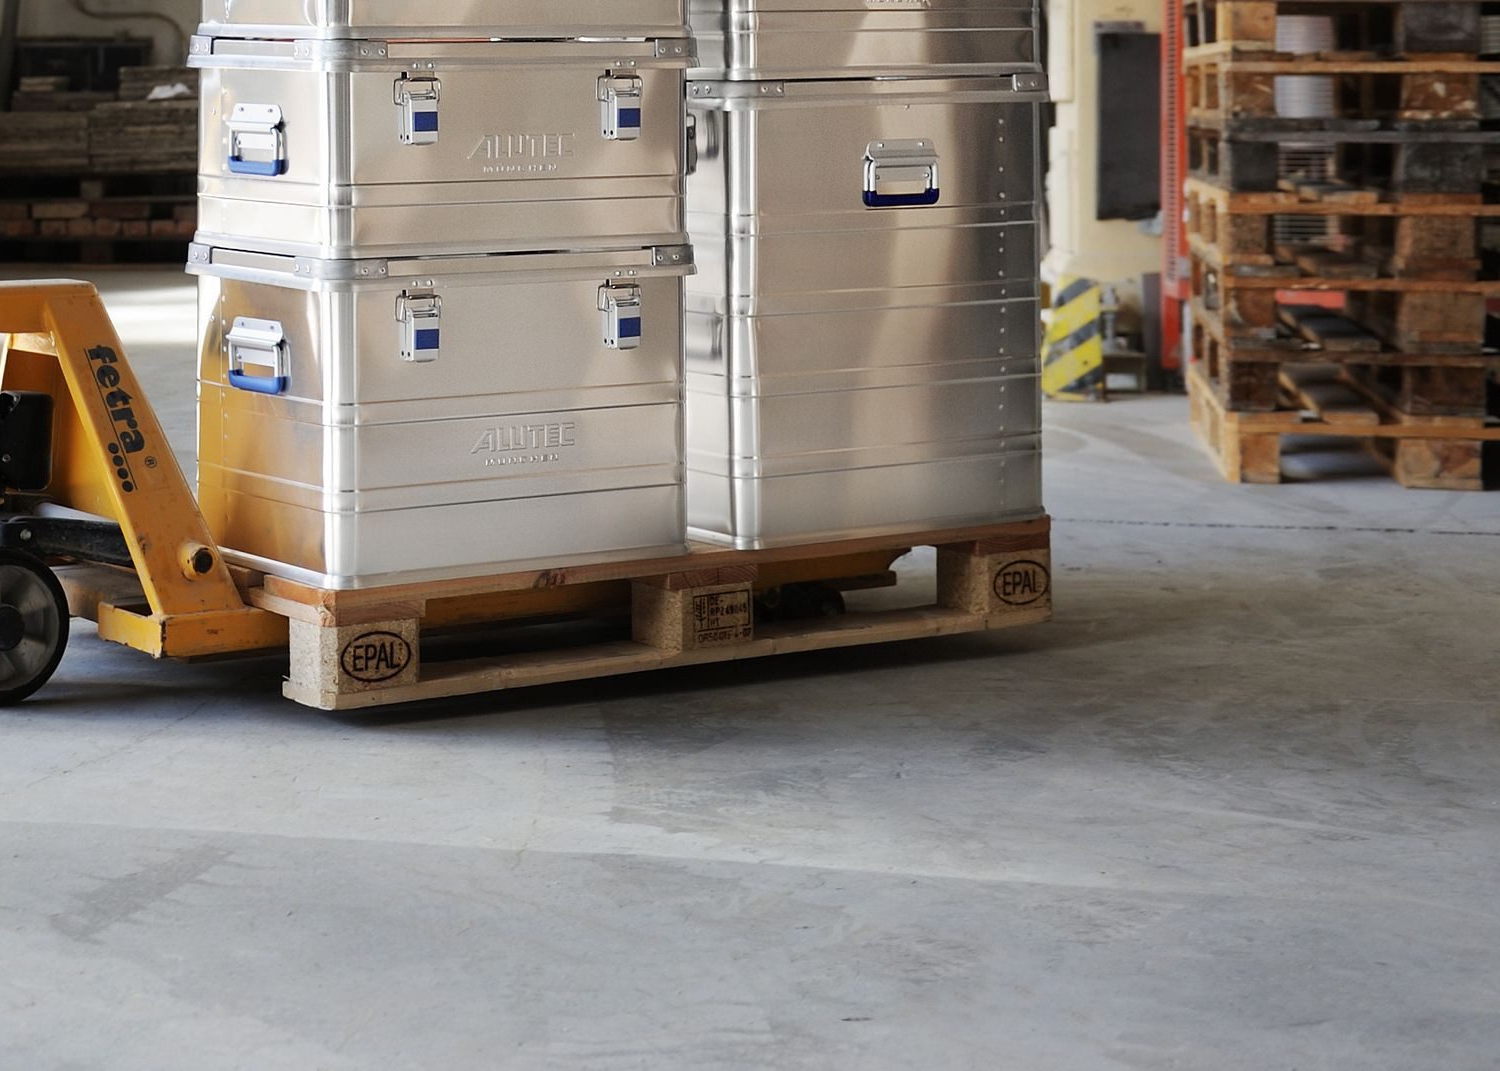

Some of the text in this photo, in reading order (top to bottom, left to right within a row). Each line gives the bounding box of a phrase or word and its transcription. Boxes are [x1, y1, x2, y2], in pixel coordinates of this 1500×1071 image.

[467, 133, 575, 159] ALUTEC
[471, 422, 575, 454] ALUTEC
[1003, 569, 1041, 597] EPAL
[353, 640, 402, 672] EPAL
